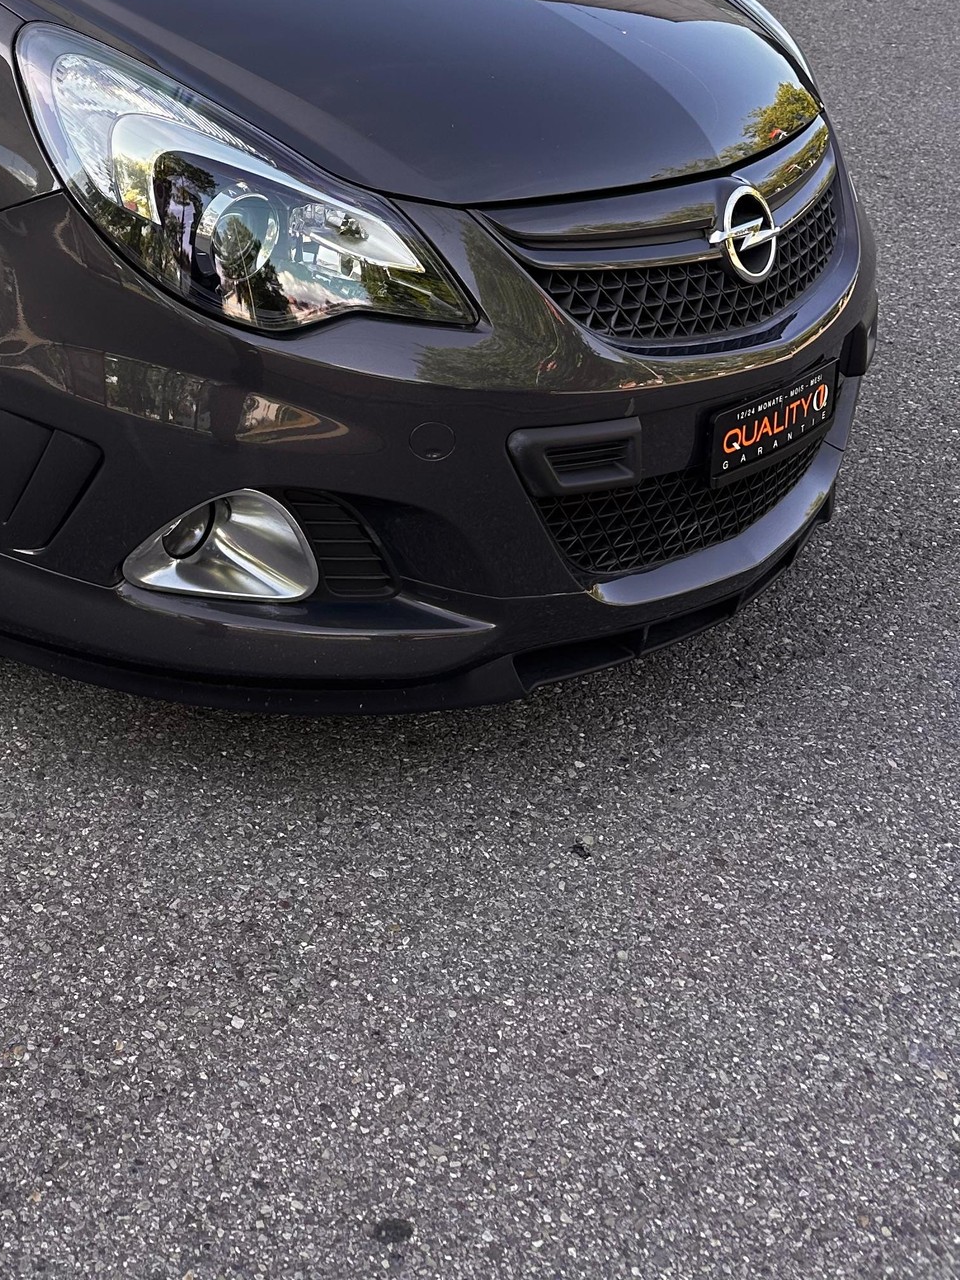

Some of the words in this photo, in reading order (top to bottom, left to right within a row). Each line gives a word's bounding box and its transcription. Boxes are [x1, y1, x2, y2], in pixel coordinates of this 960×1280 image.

[737, 407, 755, 420] 12/24
[757, 395, 783, 412] MONATE
[789, 384, 804, 397] MOIS
[810, 374, 823, 386] MESI
[722, 411, 826, 469] GARANTIE
